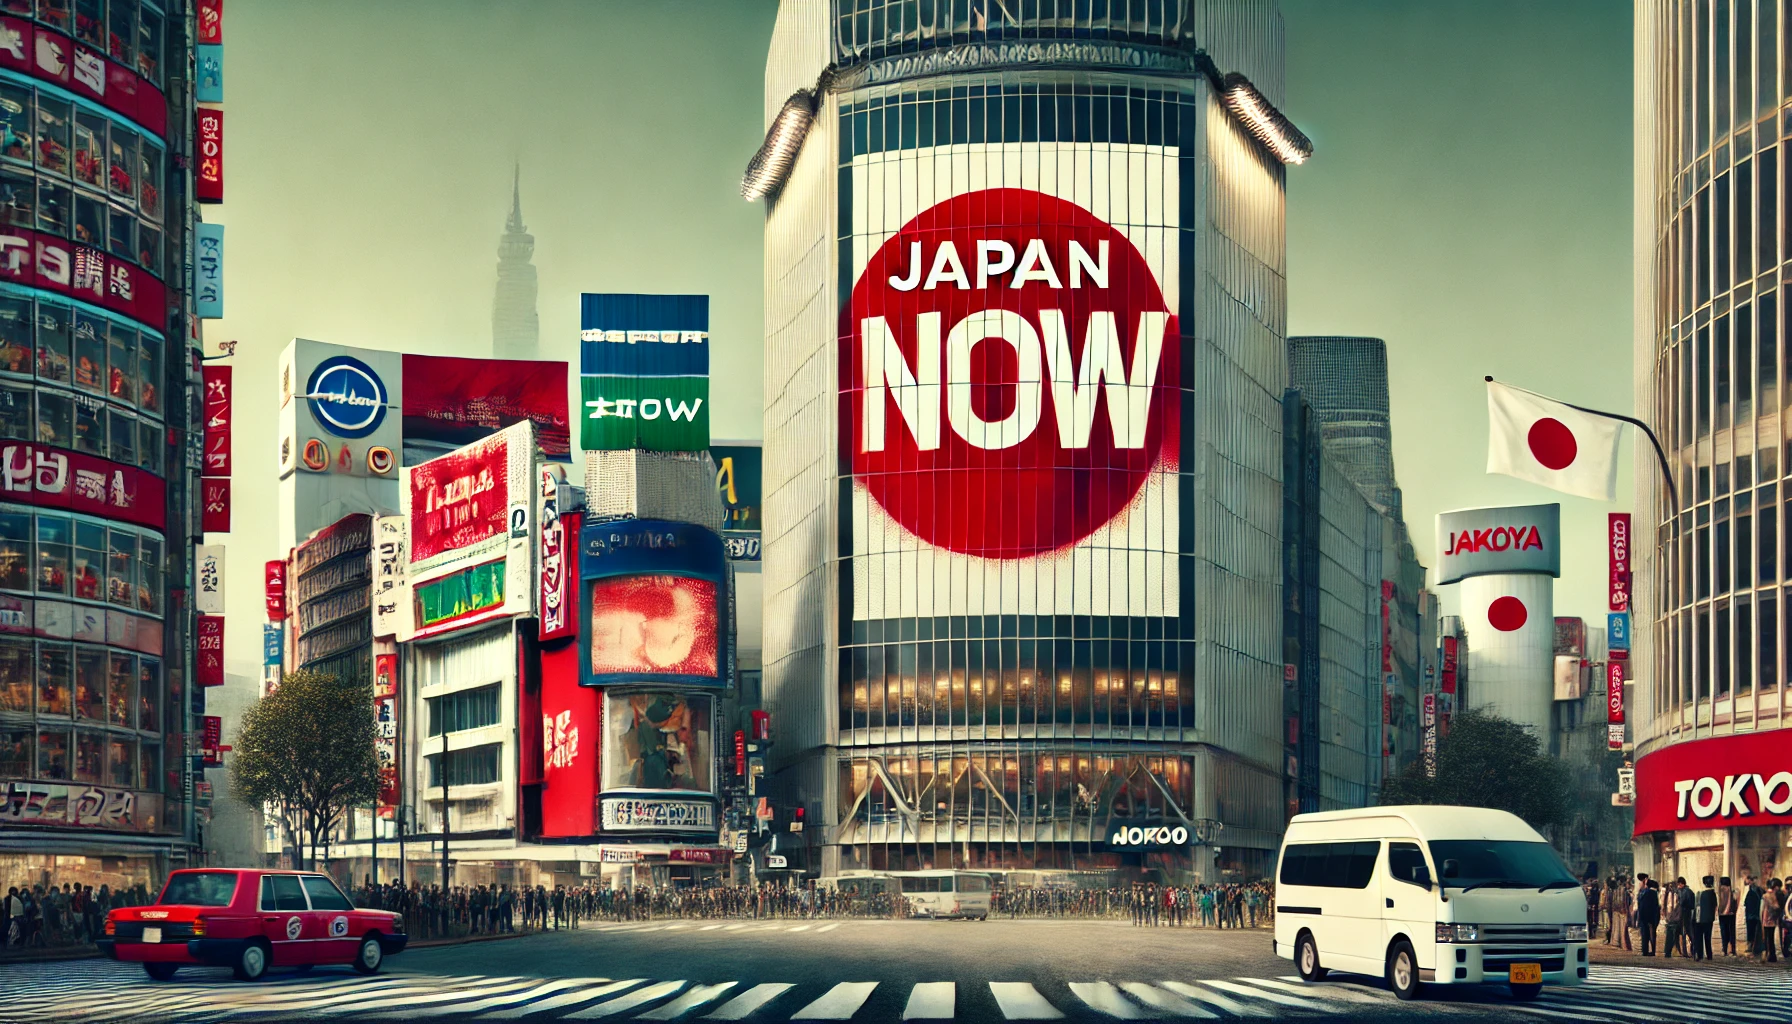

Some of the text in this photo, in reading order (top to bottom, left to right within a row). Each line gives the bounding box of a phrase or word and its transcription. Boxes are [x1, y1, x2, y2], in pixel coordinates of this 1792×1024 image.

[888, 239, 1110, 292] JAPAN
[861, 309, 1168, 454] NOW
[1444, 525, 1543, 556] JAKOYA
[1674, 771, 1792, 818] TOKYO
